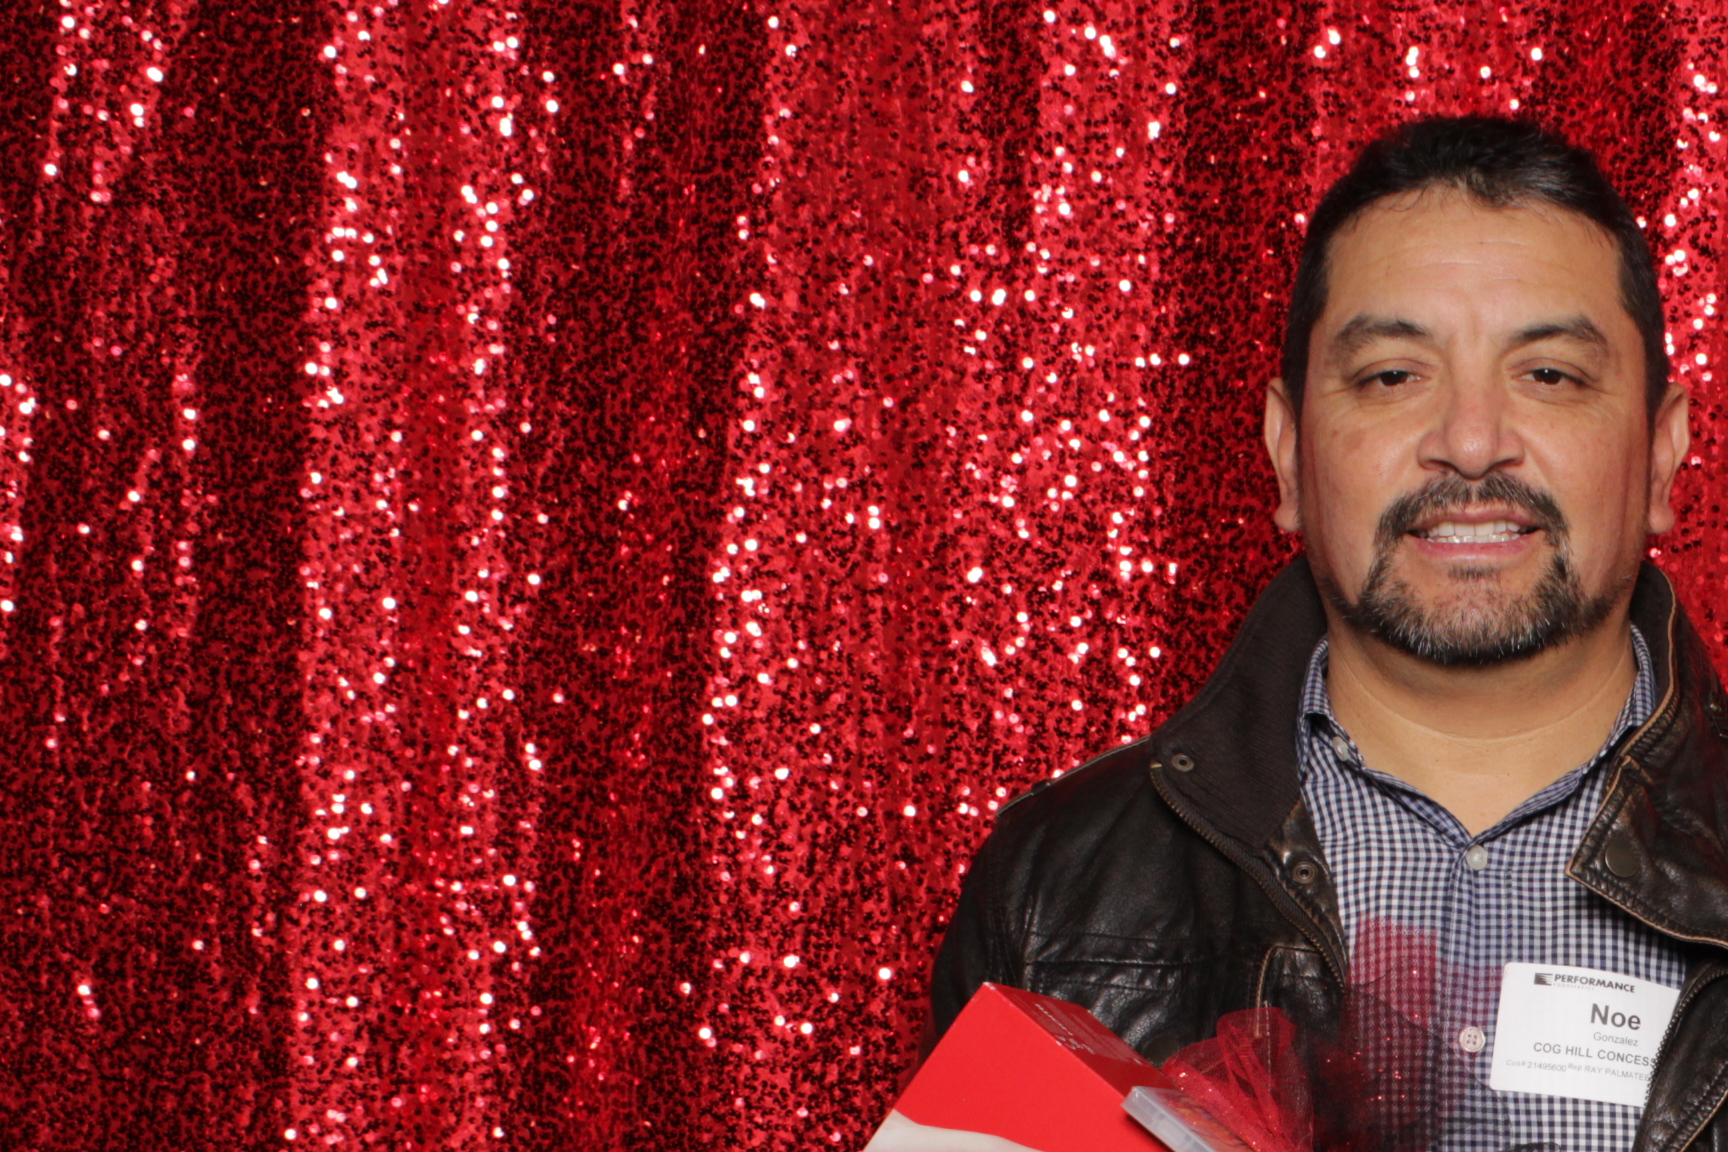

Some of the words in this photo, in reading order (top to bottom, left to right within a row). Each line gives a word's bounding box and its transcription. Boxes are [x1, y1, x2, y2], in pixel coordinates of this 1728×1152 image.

[1554, 973, 1635, 993] PERFORMANCE
[1590, 1003, 1641, 1030] Noe
[1593, 1032, 1639, 1047] Gonzalez
[1533, 1042, 1561, 1055] COG
[1565, 1045, 1593, 1058] HILL
[1584, 1065, 1602, 1074] RAY
